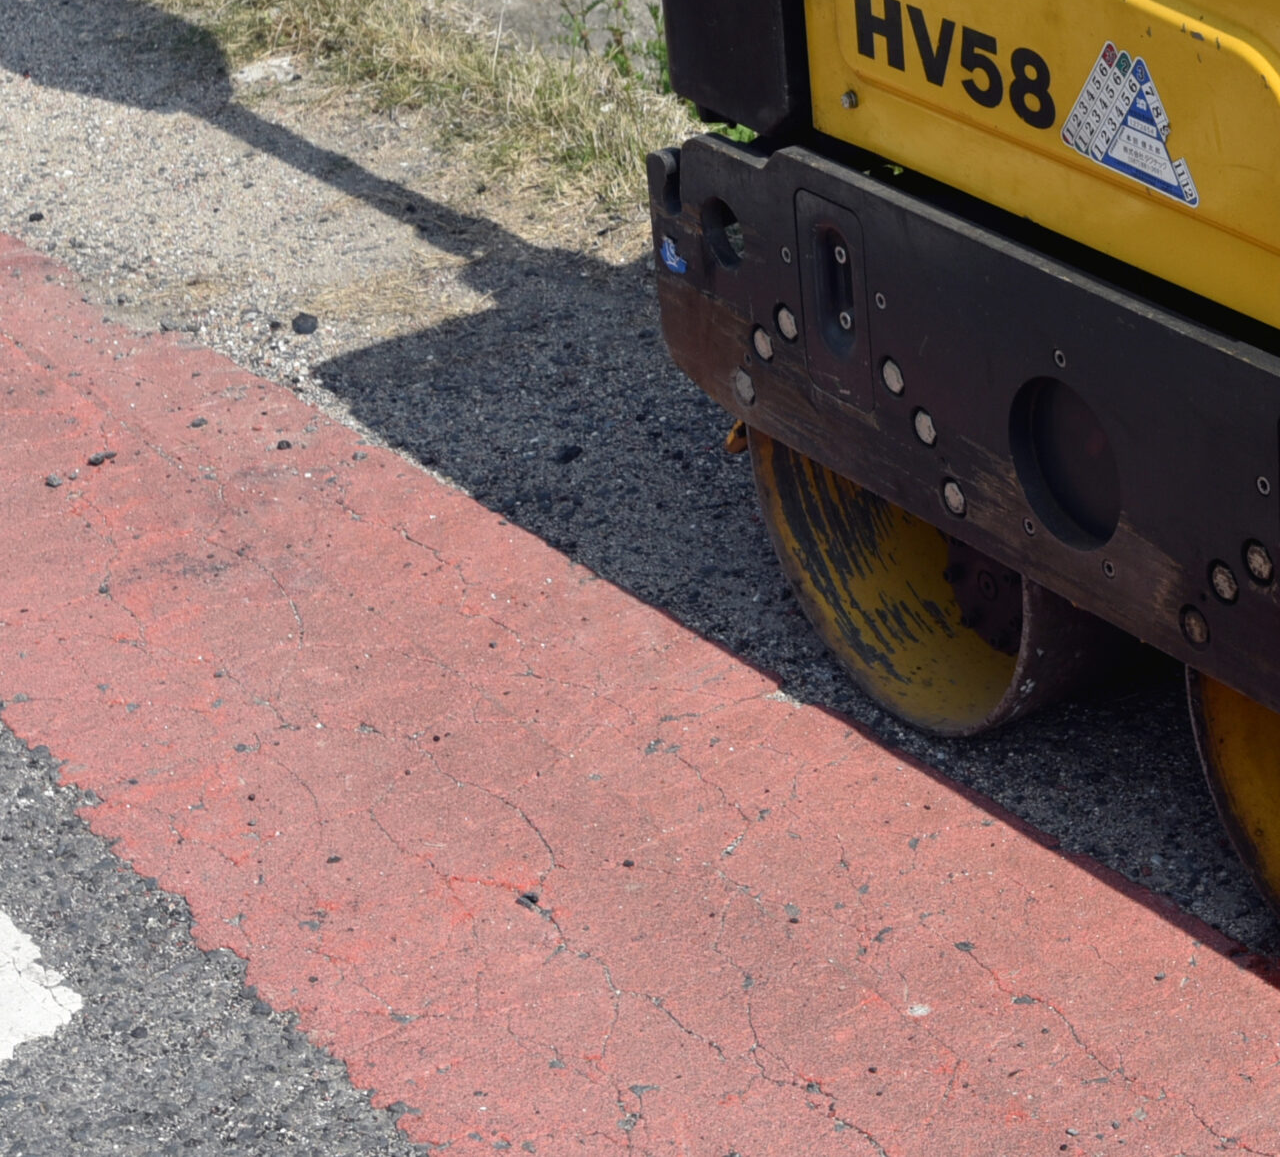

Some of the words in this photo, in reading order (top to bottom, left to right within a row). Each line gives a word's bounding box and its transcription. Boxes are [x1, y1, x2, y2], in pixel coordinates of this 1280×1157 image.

[1065, 126, 1074, 140] 1
[1073, 114, 1082, 126] 2
[1080, 102, 1088, 114] 3
[1087, 90, 1095, 102] 4
[1092, 76, 1101, 90] 5
[1099, 64, 1107, 77] 6
[1078, 134, 1087, 148] 1
[1085, 123, 1094, 135] 2
[1092, 110, 1101, 123] 3
[1099, 98, 1108, 110] 4
[1106, 86, 1115, 98] 5
[1113, 72, 1122, 85] 6
[1137, 66, 1144, 81] 3
[1094, 145, 1104, 159] 1
[1101, 131, 1111, 144] 2
[1108, 118, 1117, 131] 3
[1116, 105, 1124, 118] 4
[1121, 92, 1130, 105] 5
[1129, 80, 1137, 92] 6
[1145, 87, 1154, 97] 7
[1152, 106, 1162, 118] 8
[1174, 163, 1184, 178] 11
[1181, 182, 1193, 198] 12
